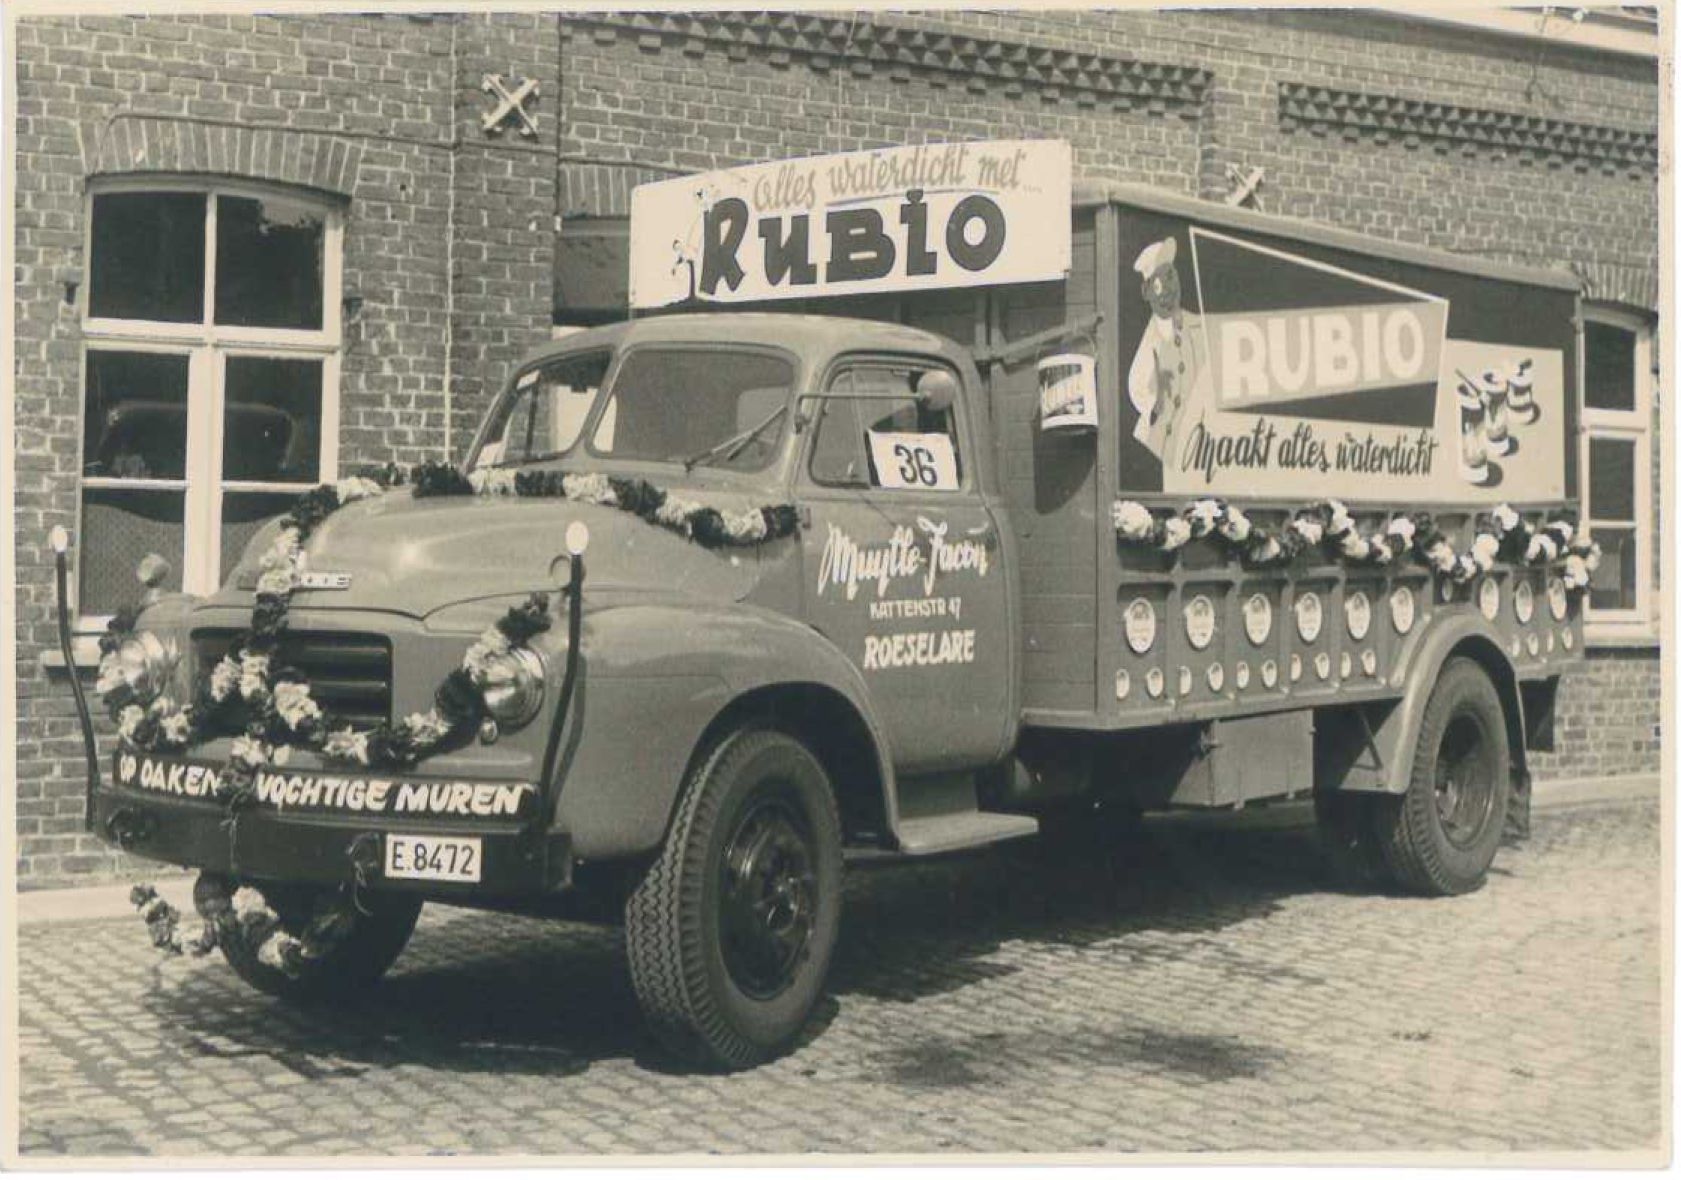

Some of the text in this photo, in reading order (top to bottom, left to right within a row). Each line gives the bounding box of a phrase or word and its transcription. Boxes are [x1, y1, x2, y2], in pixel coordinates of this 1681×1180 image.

[1220, 309, 1425, 399] RUBIO
[894, 444, 938, 487] 36
[1336, 427, 1439, 476] waterdicht
[863, 629, 976, 670] ROESELARE
[394, 783, 524, 815] MUREN
[392, 842, 475, 875] E.8472
